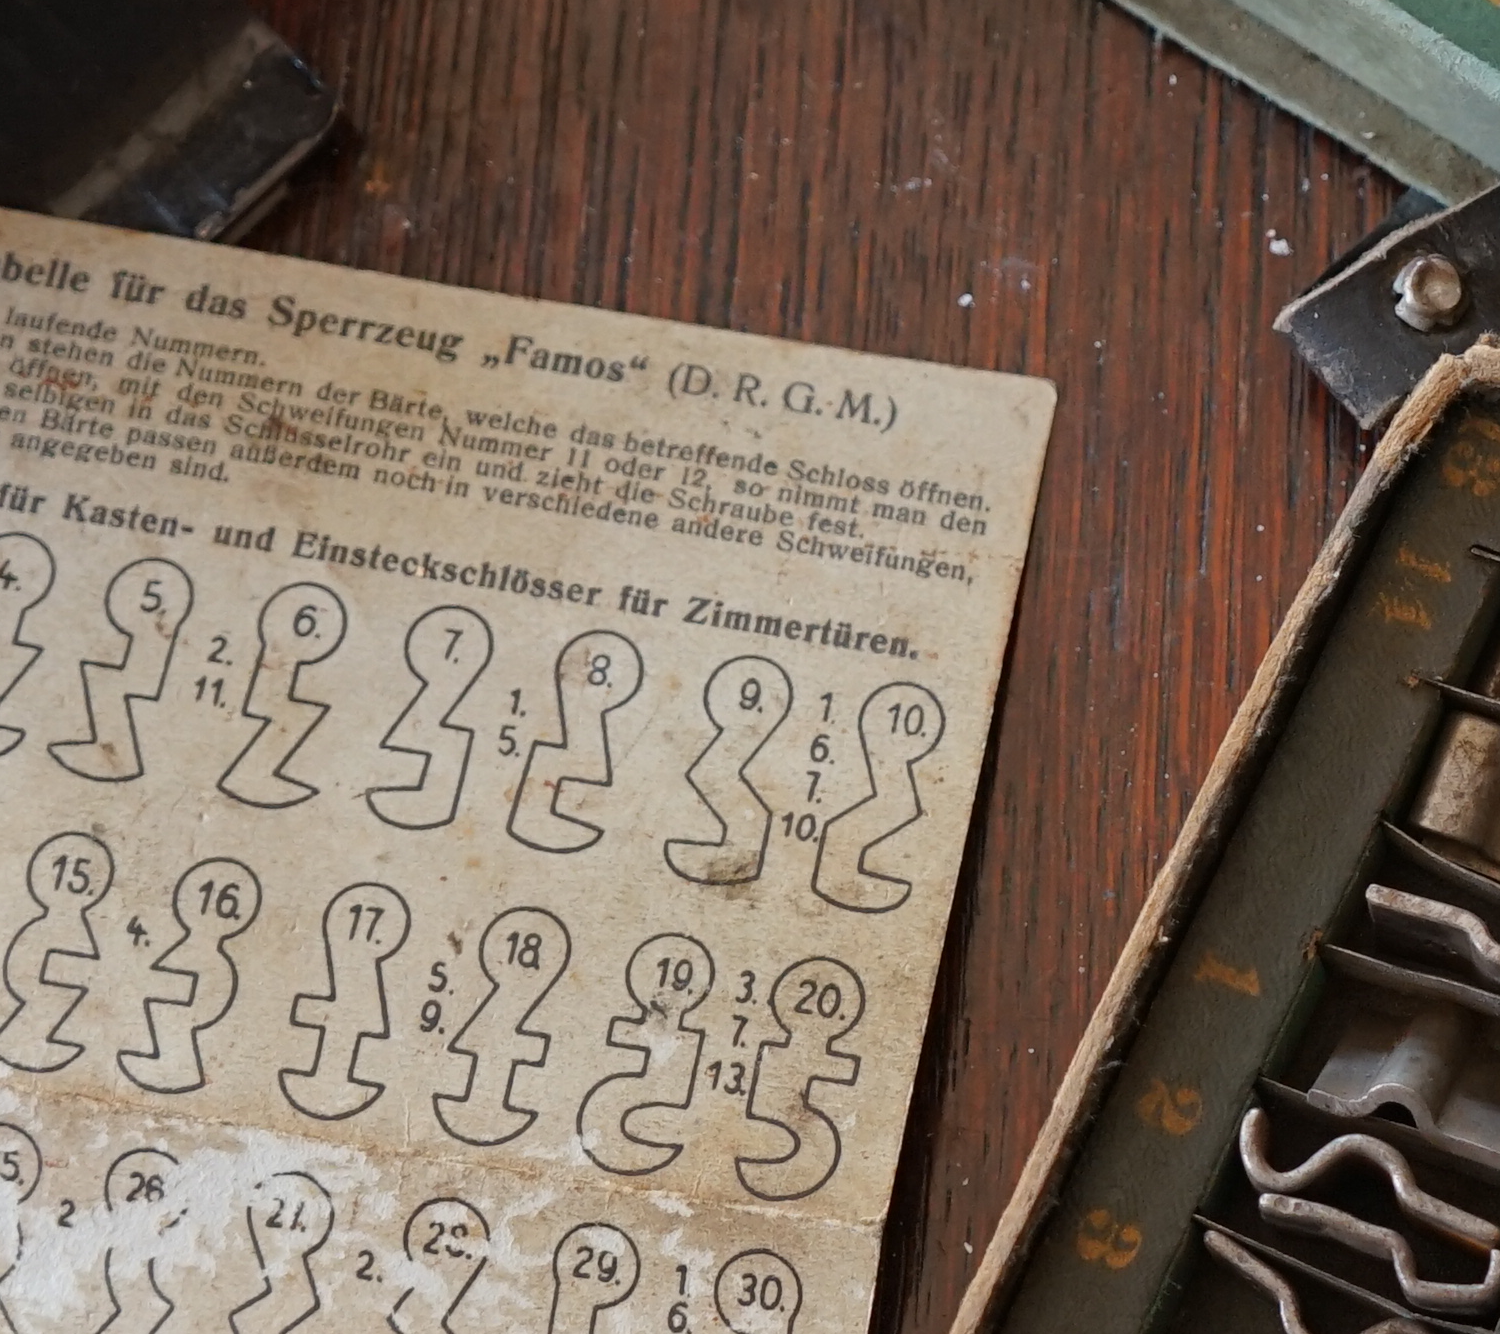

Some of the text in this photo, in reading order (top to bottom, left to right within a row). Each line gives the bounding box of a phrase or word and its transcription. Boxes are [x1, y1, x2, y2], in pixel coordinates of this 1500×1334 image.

[4, 306, 117, 342] laufende
[130, 326, 266, 367] Nummern.
[108, 268, 167, 309] für
[182, 281, 250, 323] das
[266, 294, 464, 363] Sperrzeug
[664, 359, 722, 402] (D.
[730, 369, 771, 410] R.
[779, 378, 826, 419] G.
[834, 388, 898, 433] M.)
[27, 337, 114, 367] stehen
[175, 357, 303, 397] Nummern
[466, 409, 558, 439] welche
[622, 431, 779, 476] betreffende
[786, 458, 890, 496] Schloss
[898, 479, 991, 513] öffnen.
[3, 382, 116, 415] selbigen
[535, 467, 604, 496] zieht
[667, 486, 794, 527] Schraube
[807, 510, 864, 539] fest.
[9, 432, 157, 470] angegeben
[169, 455, 229, 483] sind.
[236, 392, 425, 442] Schweifungen
[437, 422, 554, 462] Nummer
[604, 456, 667, 482] oder
[776, 483, 861, 515] nimmt
[39, 408, 115, 440] Bärte
[125, 426, 217, 457] passen
[370, 465, 438, 495] noch
[482, 485, 659, 530] verschiedene
[671, 514, 764, 547] andere
[775, 529, 974, 587] Schweifungen,
[61, 493, 194, 538] Kasten-
[211, 521, 277, 555] und
[291, 530, 603, 606] Einsteckschlösser
[617, 585, 669, 618] für
[682, 596, 919, 661] Zimmertüren.
[138, 579, 170, 616] 5.
[290, 603, 324, 639] 6.
[441, 627, 464, 663] 7.
[192, 675, 228, 709] 11.
[586, 653, 613, 689] 8.
[738, 676, 766, 713] 9.
[884, 701, 929, 739] 10.
[781, 811, 823, 846] 10.
[49, 853, 98, 897] 15.
[348, 903, 386, 945] 17.
[654, 955, 696, 995] 19.
[1194, 952, 1260, 997] 1
[793, 978, 846, 1021] 20.
[707, 1059, 747, 1097] 13.
[1137, 1079, 1200, 1135] 2
[1077, 1210, 1142, 1268] 3
[571, 1246, 621, 1286] 29.
[736, 1273, 785, 1313] 30.
